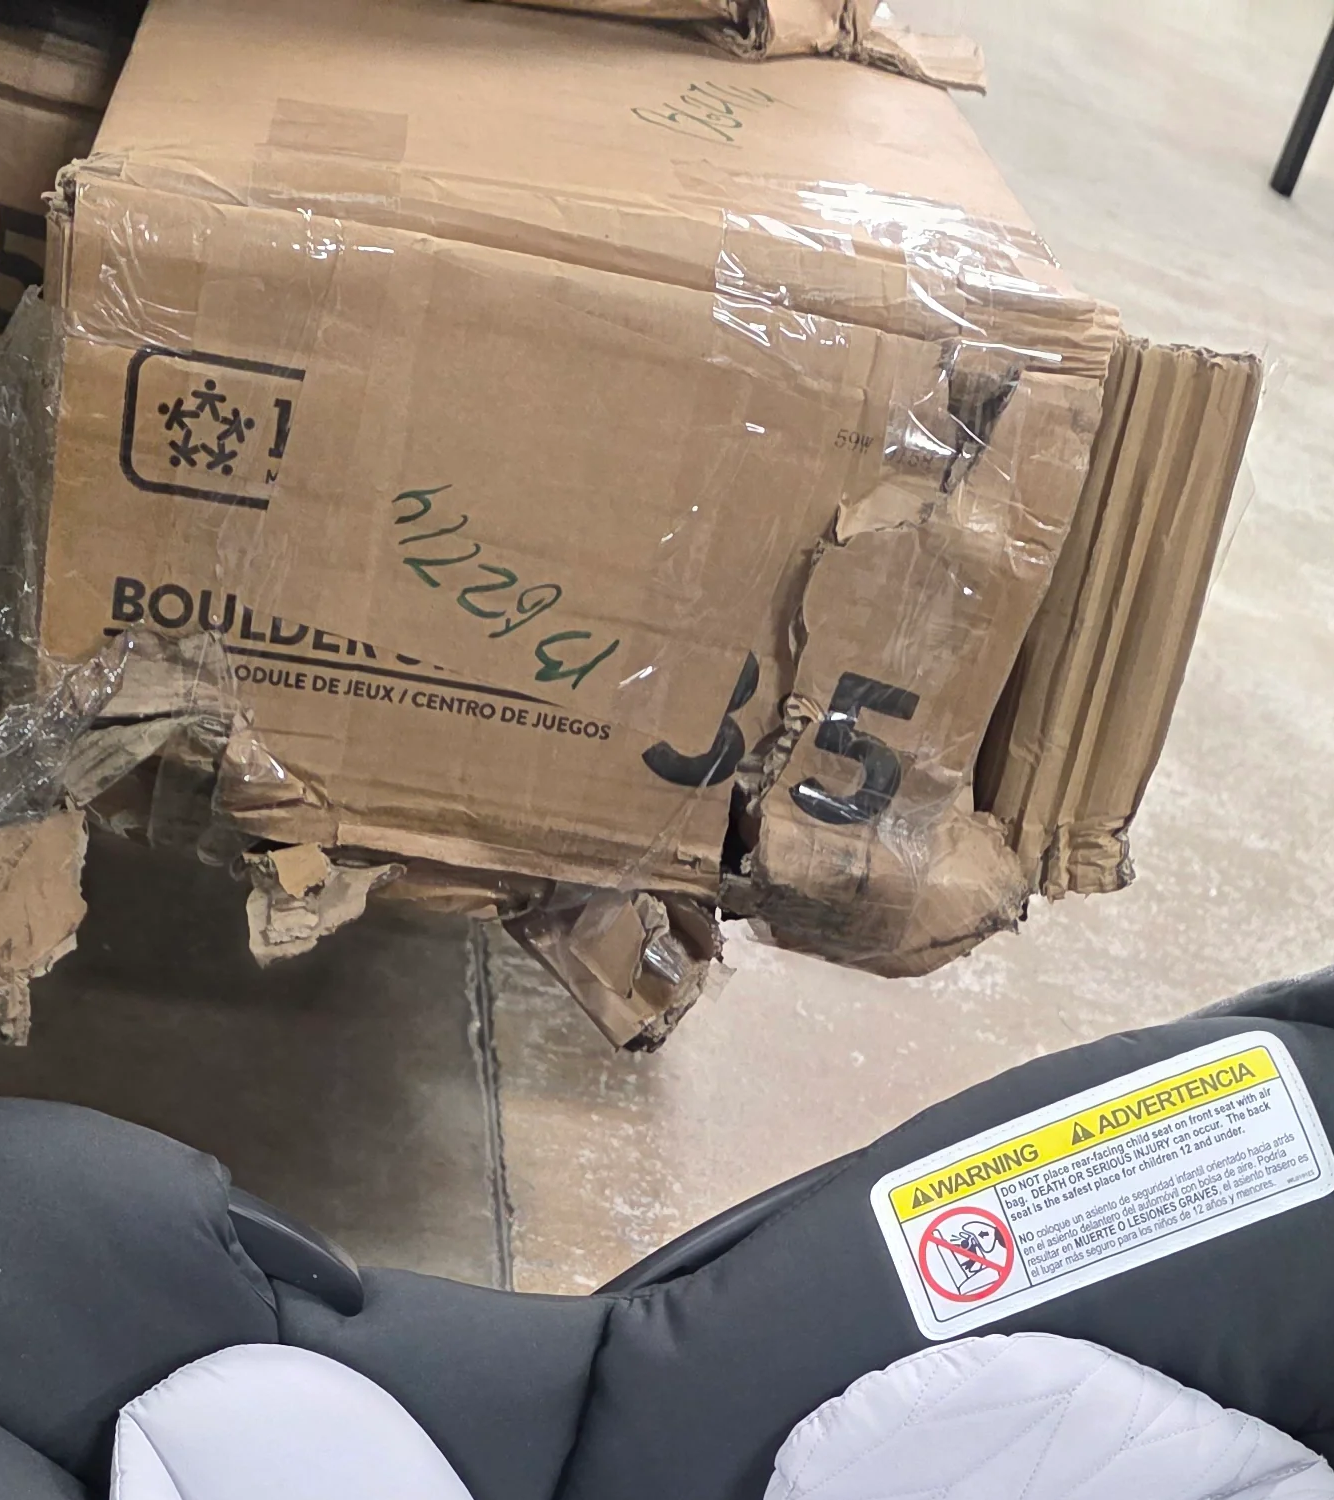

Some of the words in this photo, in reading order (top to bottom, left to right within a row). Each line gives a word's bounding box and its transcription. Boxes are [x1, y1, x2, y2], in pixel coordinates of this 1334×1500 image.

[234, 664, 308, 691] ODULE
[312, 674, 340, 696] DE
[343, 677, 395, 704] JEUX
[411, 690, 497, 721] CENTRO
[500, 705, 529, 726] DE
[532, 711, 613, 742] JUEGOS
[789, 671, 920, 825] 5
[930, 1145, 1038, 1198] WARNING
[1099, 1064, 1254, 1133] ADVERTENCIA
[1000, 1184, 1017, 1197] DO
[1018, 1174, 1039, 1190] NOT
[1043, 1166, 1069, 1183] place
[1071, 1144, 1124, 1170] rear-facing
[1125, 1132, 1150, 1148] child
[1151, 1124, 1173, 1138] seat
[1175, 1120, 1187, 1130] on
[1188, 1109, 1213, 1124] front
[1214, 1101, 1235, 1115] seat
[1236, 1093, 1257, 1107] with
[1259, 1088, 1271, 1099] air
[1005, 1196, 1027, 1209] bag.
[1031, 1178, 1067, 1199] DEATH
[1068, 1171, 1085, 1184] OR
[1086, 1153, 1132, 1177] SERIOUS
[1133, 1137, 1169, 1159] INJURY
[1173, 1132, 1191, 1144] can
[1193, 1121, 1223, 1137] occur.
[1225, 1112, 1245, 1124] The
[1246, 1102, 1271, 1117] back
[1010, 1206, 1032, 1221] seat
[1032, 1203, 1043, 1212] is
[1043, 1196, 1061, 1208] the
[1062, 1182, 1093, 1201] safest
[1094, 1173, 1120, 1191] place
[1121, 1166, 1136, 1178] for
[1139, 1151, 1178, 1171] children
[1179, 1144, 1192, 1155] 12
[1193, 1136, 1212, 1150] and
[1214, 1126, 1245, 1142] under.
[1018, 1231, 1034, 1244] NO
[1036, 1219, 1071, 1238] coloque
[1071, 1214, 1084, 1224] un
[1085, 1201, 1117, 1219] asiento
[1119, 1195, 1131, 1206] de
[1132, 1177, 1175, 1201] seguridad
[1175, 1165, 1205, 1184] infantil
[1206, 1152, 1246, 1172] orientado
[1247, 1142, 1272, 1157] hacia
[1273, 1133, 1295, 1148] atrás
[1023, 1246, 1035, 1256] en
[1037, 1240, 1045, 1250] el
[1047, 1228, 1078, 1247] asiento
[1080, 1212, 1120, 1233] delantero
[1122, 1204, 1136, 1217] del
[1137, 1188, 1179, 1211] automóvil
[1181, 1183, 1197, 1195] con
[1197, 1173, 1222, 1188] bolsa
[1223, 1168, 1235, 1178] de
[1237, 1161, 1256, 1174] aire.
[1257, 1149, 1287, 1166] Podría
[1027, 1248, 1059, 1267] resultar
[1061, 1243, 1073, 1253] en
[1074, 1225, 1116, 1248] MUERTE
[1117, 1221, 1126, 1231] O
[1127, 1202, 1177, 1228] LESIONES
[1178, 1186, 1221, 1208] GRAVES,
[1223, 1180, 1231, 1191] el
[1233, 1170, 1264, 1188] asiento
[1265, 1158, 1296, 1175] trasero
[1297, 1154, 1309, 1163] es
[1031, 1267, 1040, 1278] el
[1040, 1259, 1063, 1274] lugar
[1065, 1252, 1084, 1265] más
[1085, 1240, 1115, 1257] seguro
[1117, 1231, 1138, 1247] para
[1137, 1225, 1153, 1236] los
[1153, 1216, 1178, 1231] niños
[1179, 1210, 1191, 1221] de
[1193, 1204, 1204, 1215] 12
[1205, 1196, 1227, 1211] años
[1228, 1194, 1234, 1205] y
[1236, 1180, 1276, 1199] menores.
